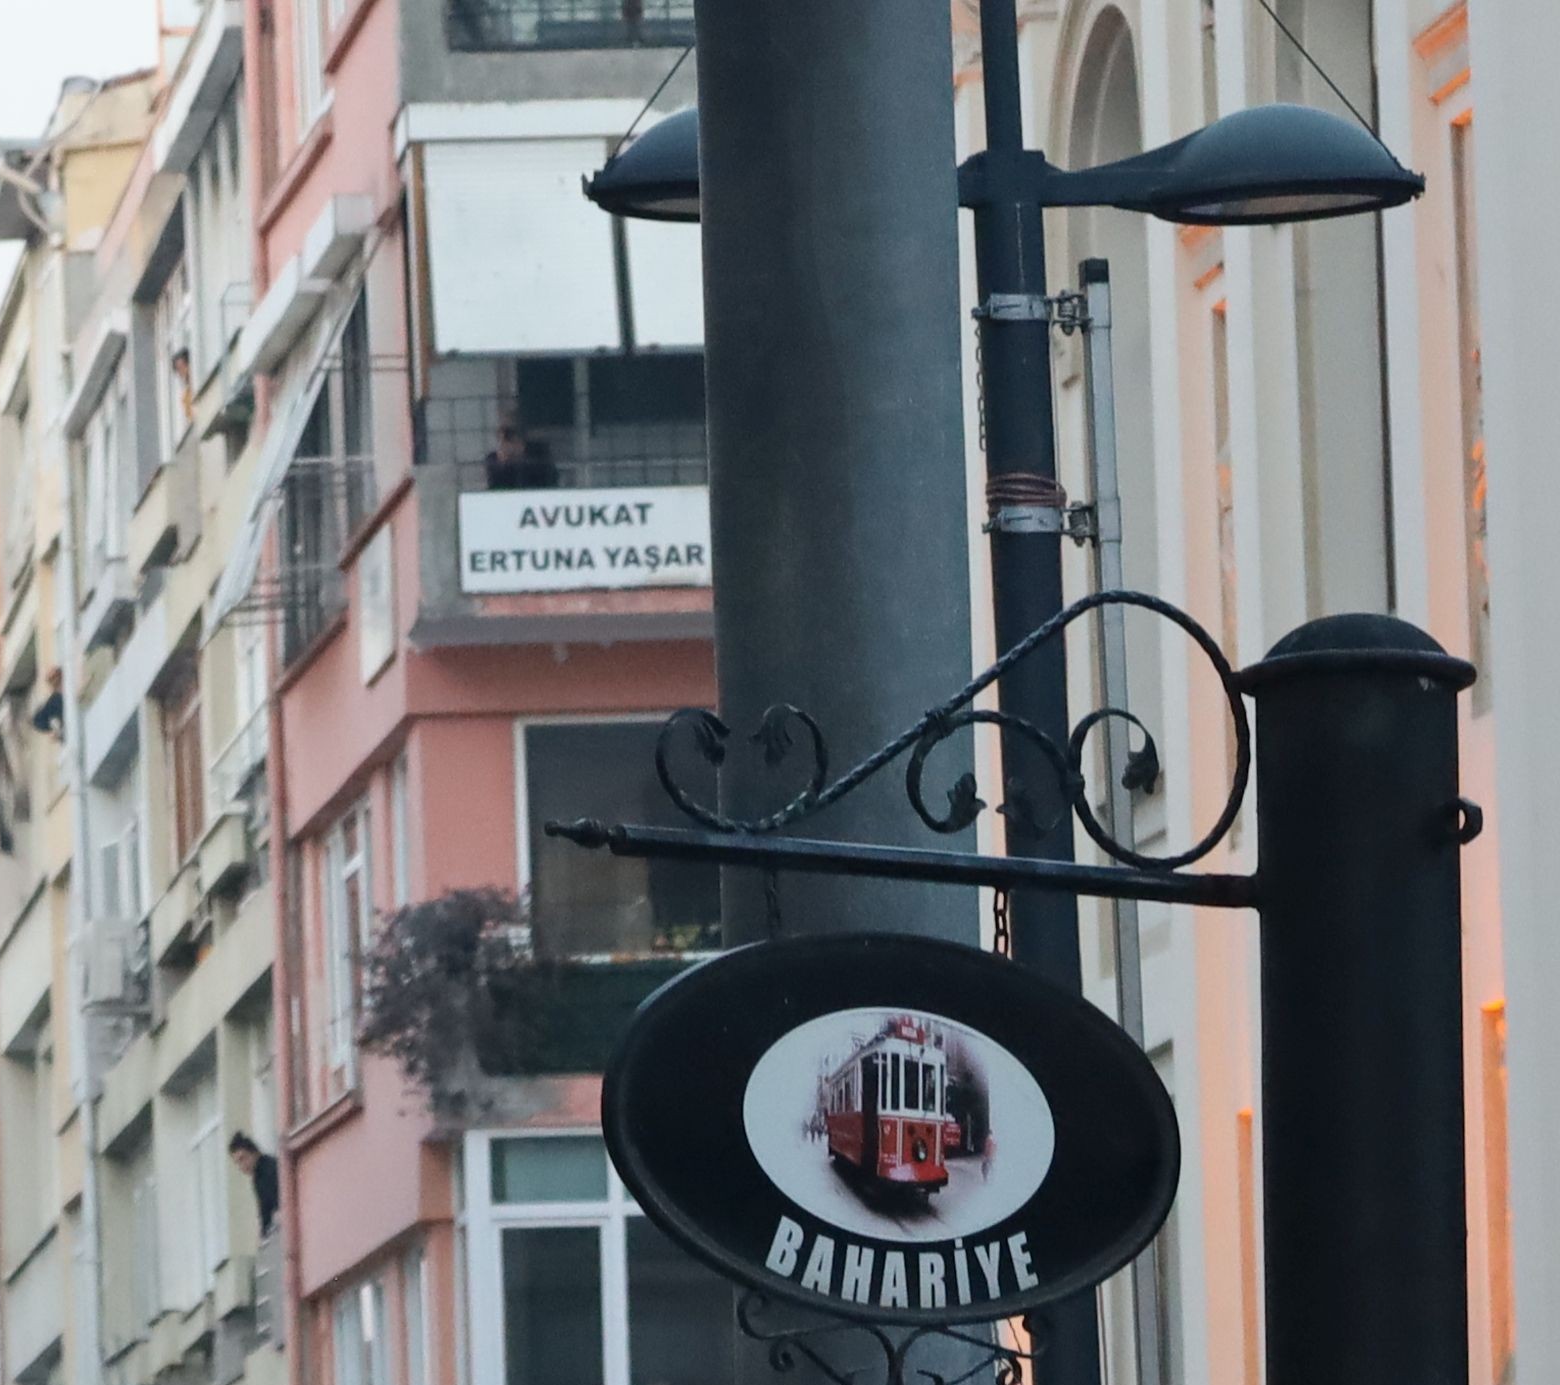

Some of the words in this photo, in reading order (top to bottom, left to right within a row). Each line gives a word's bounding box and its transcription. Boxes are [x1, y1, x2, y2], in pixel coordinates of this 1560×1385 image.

[519, 501, 654, 530] AVUKAT
[469, 547, 596, 574] ERTUNA
[603, 544, 704, 573] YAŞAR
[764, 1215, 1039, 1309] BAHARİYE
